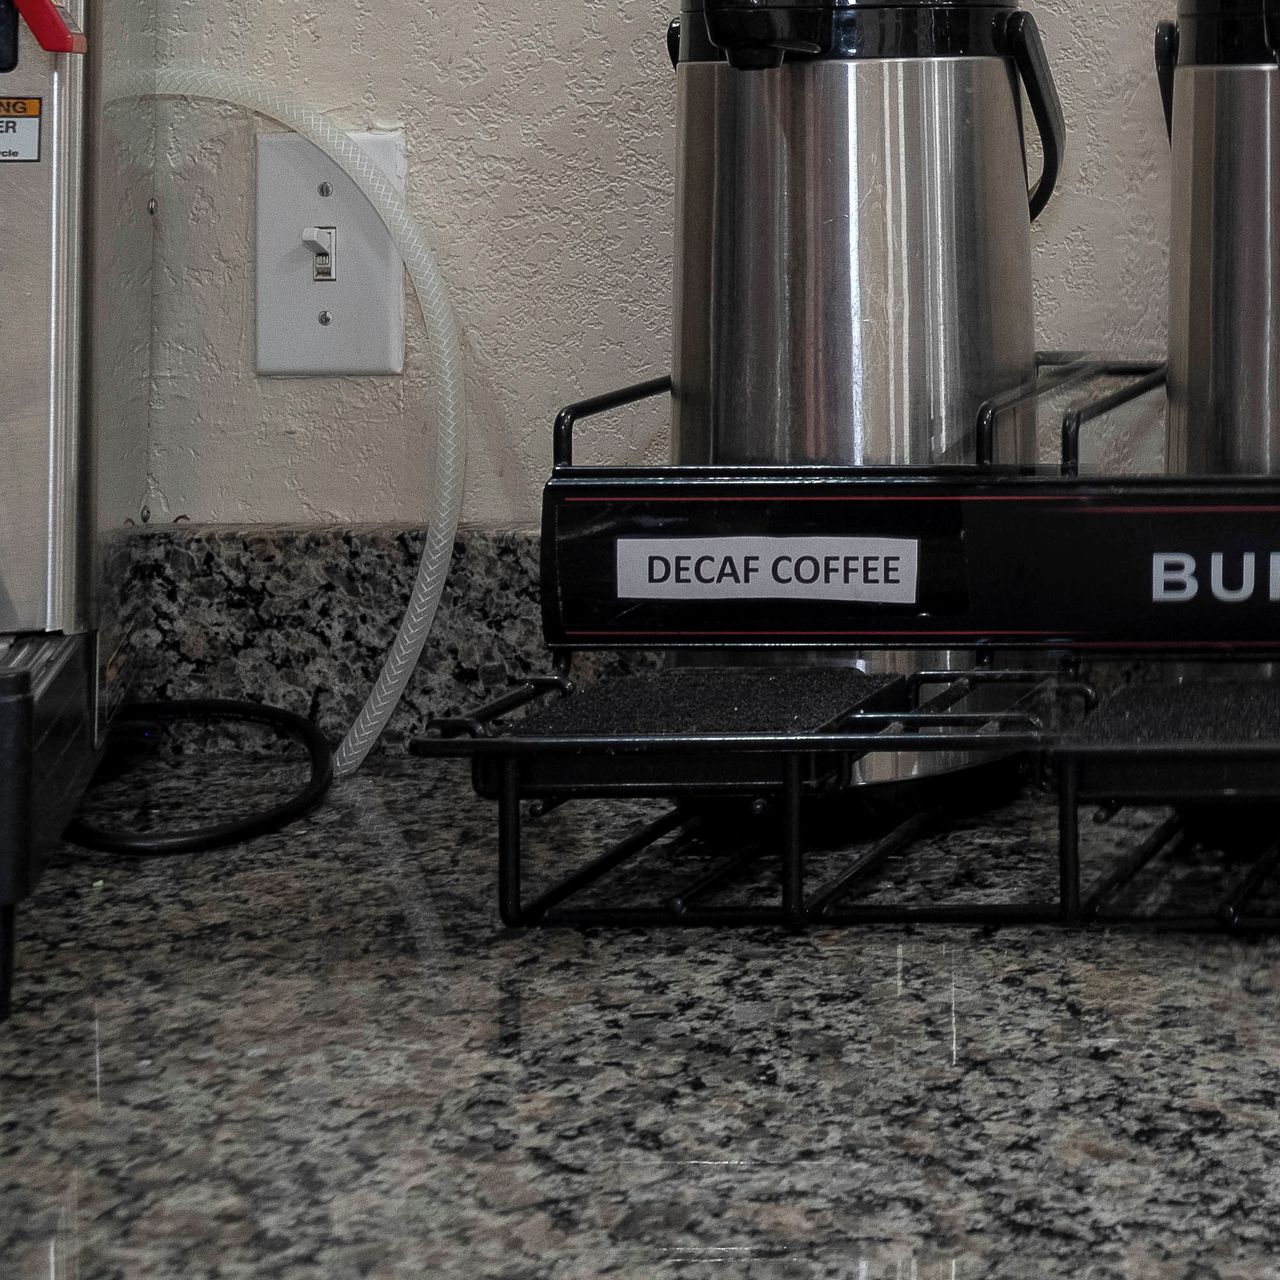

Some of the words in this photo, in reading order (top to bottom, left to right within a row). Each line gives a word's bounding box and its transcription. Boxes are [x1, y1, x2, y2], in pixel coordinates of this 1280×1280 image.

[0, 149, 19, 158] cle
[648, 555, 760, 584] DECAF
[771, 555, 902, 585] COFFEE
